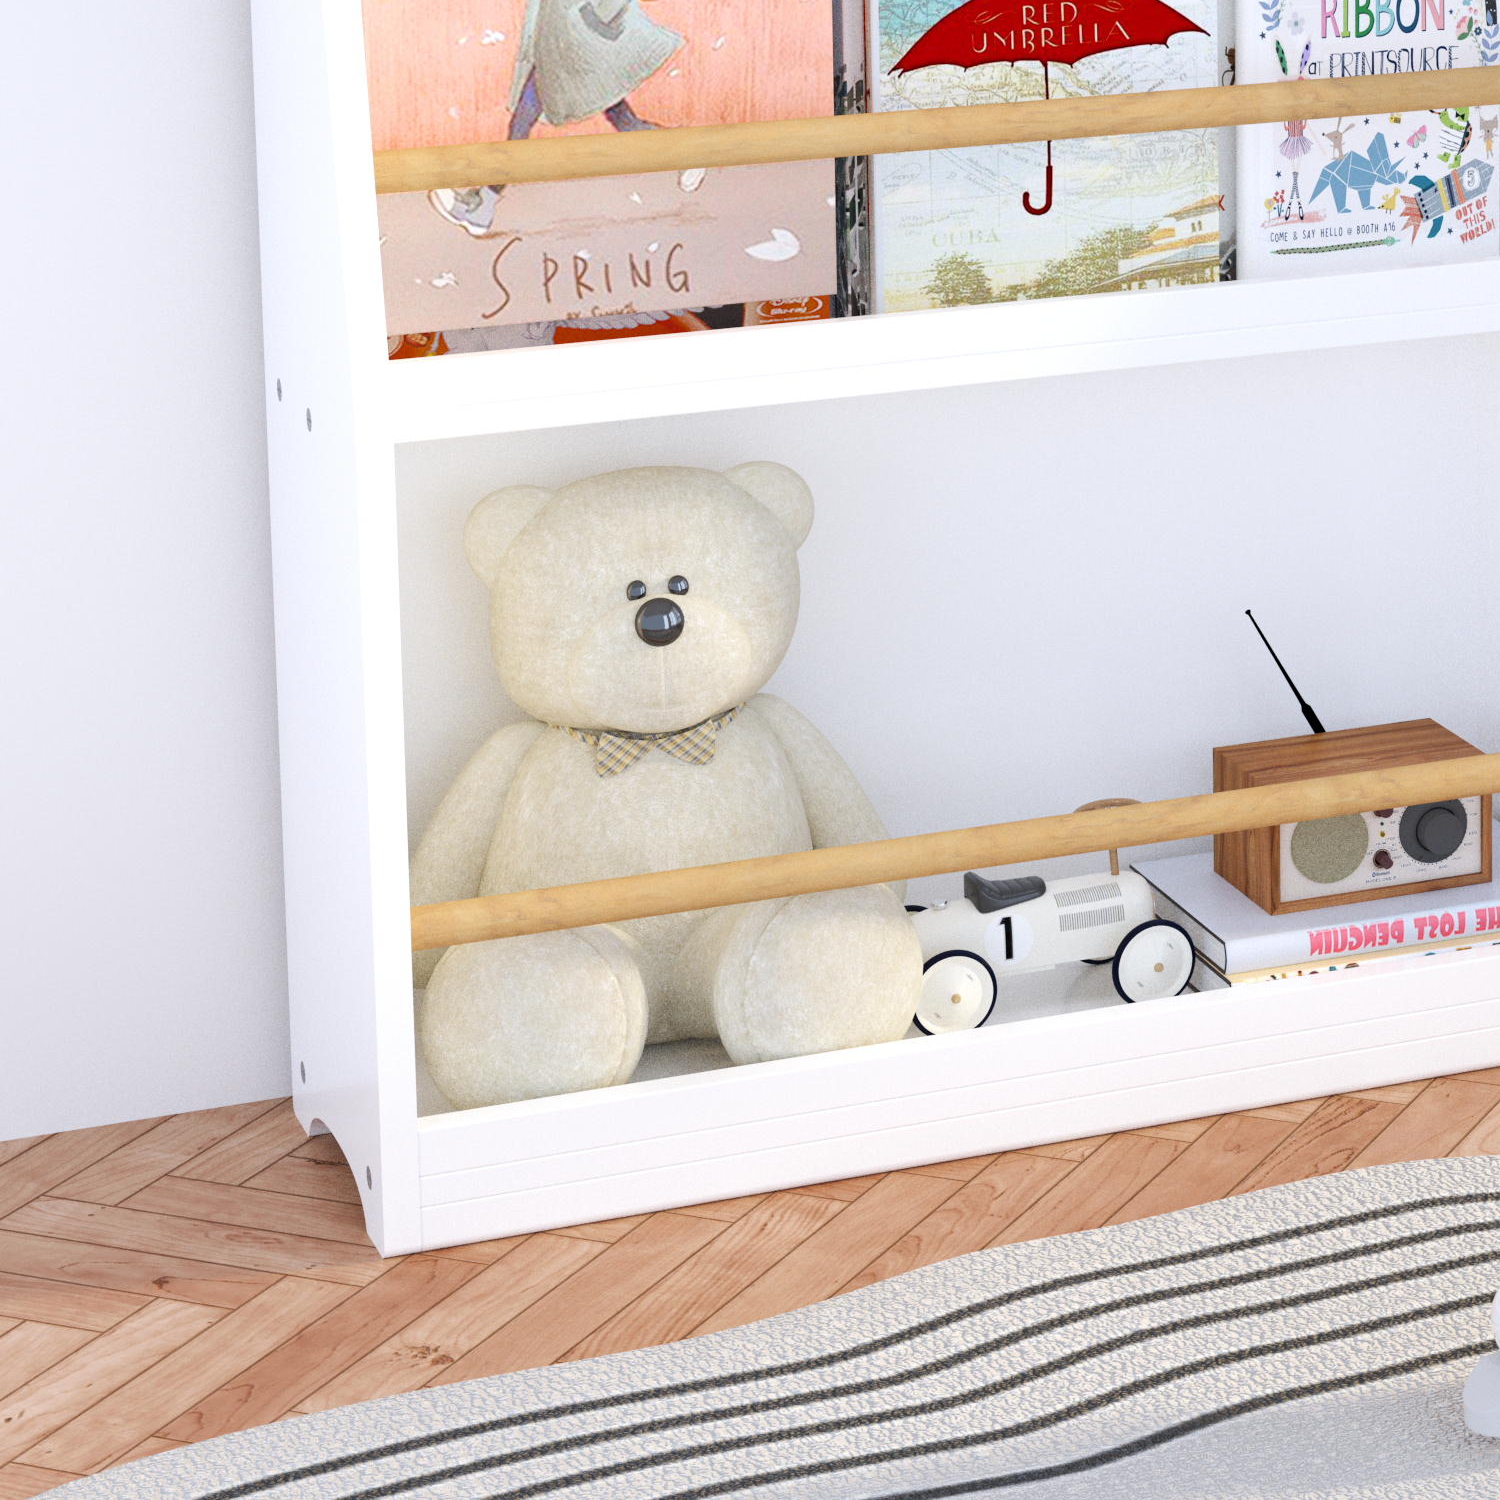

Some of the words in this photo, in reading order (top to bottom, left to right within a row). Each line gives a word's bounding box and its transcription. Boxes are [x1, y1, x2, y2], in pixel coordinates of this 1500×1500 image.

[1022, 1, 1078, 26] RED
[971, 20, 1131, 53] UMBRELLA
[1465, 170, 1477, 188] 5
[1454, 202, 1481, 222] OUT
[1474, 196, 1489, 212] OF
[1463, 212, 1487, 230] THIS
[1270, 231, 1288, 243] COME
[1303, 229, 1316, 240] SAY
[1320, 226, 1343, 238] HELLO
[1356, 223, 1379, 235] BOOTH
[1383, 222, 1396, 232] A16
[1459, 218, 1496, 245] WORLD!
[481, 237, 690, 318] SPRING
[998, 916, 1014, 960] 1
